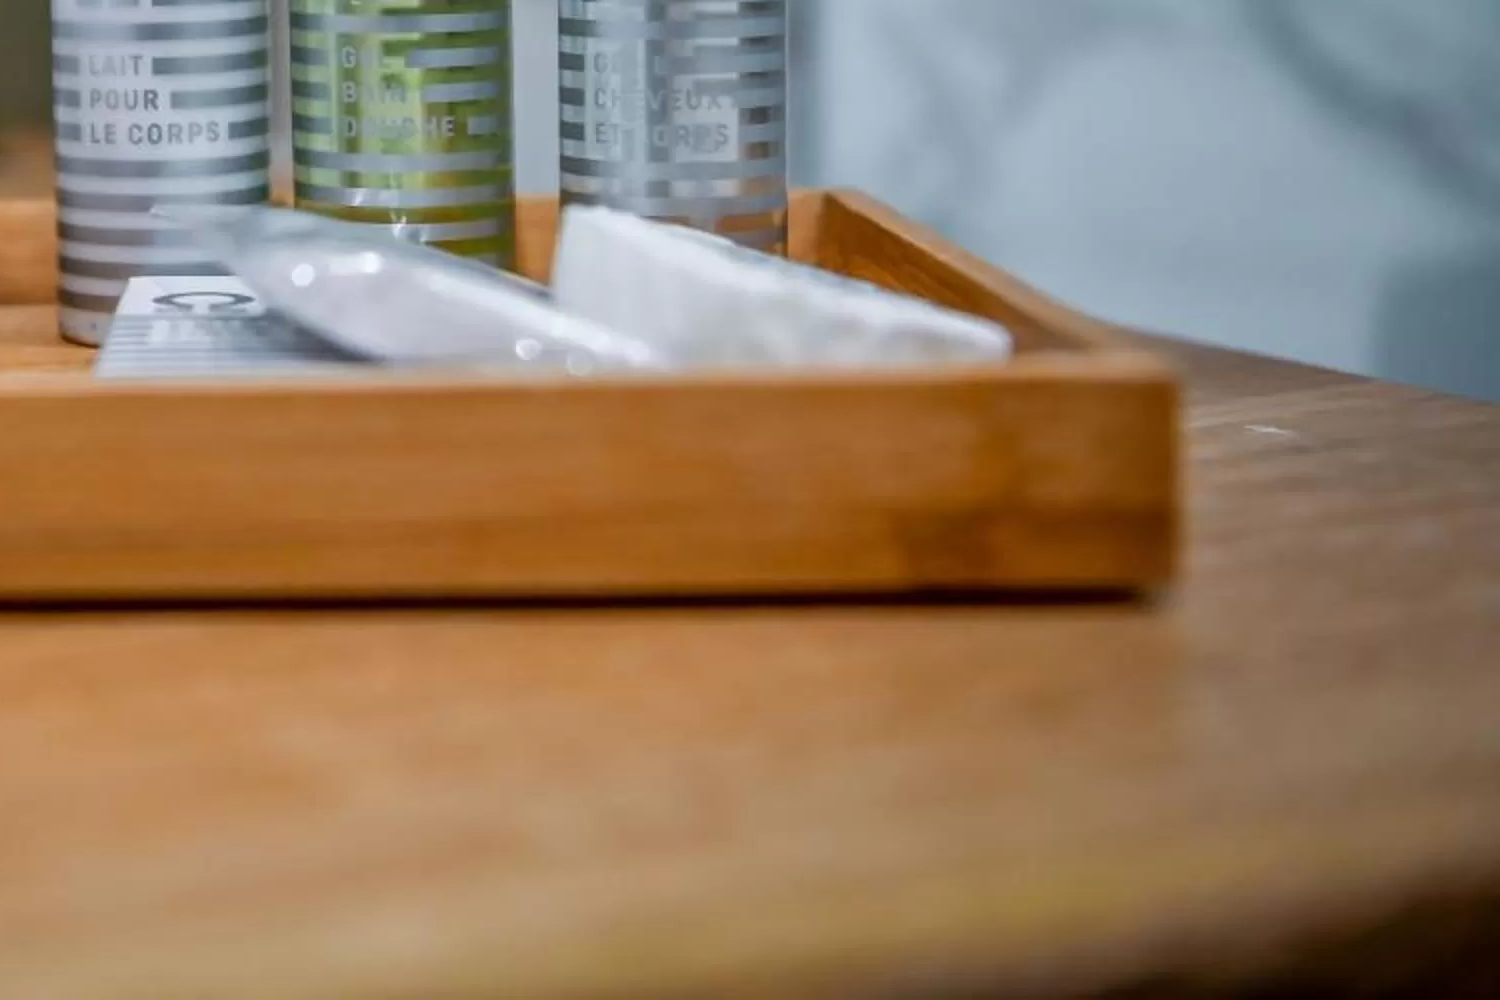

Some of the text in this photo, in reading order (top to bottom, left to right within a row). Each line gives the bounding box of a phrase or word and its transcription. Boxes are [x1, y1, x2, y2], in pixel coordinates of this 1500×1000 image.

[88, 54, 144, 77] LAIT
[89, 88, 160, 112] POUR
[90, 120, 222, 146] LE CORPS
[634, 123, 730, 148] ORPS
